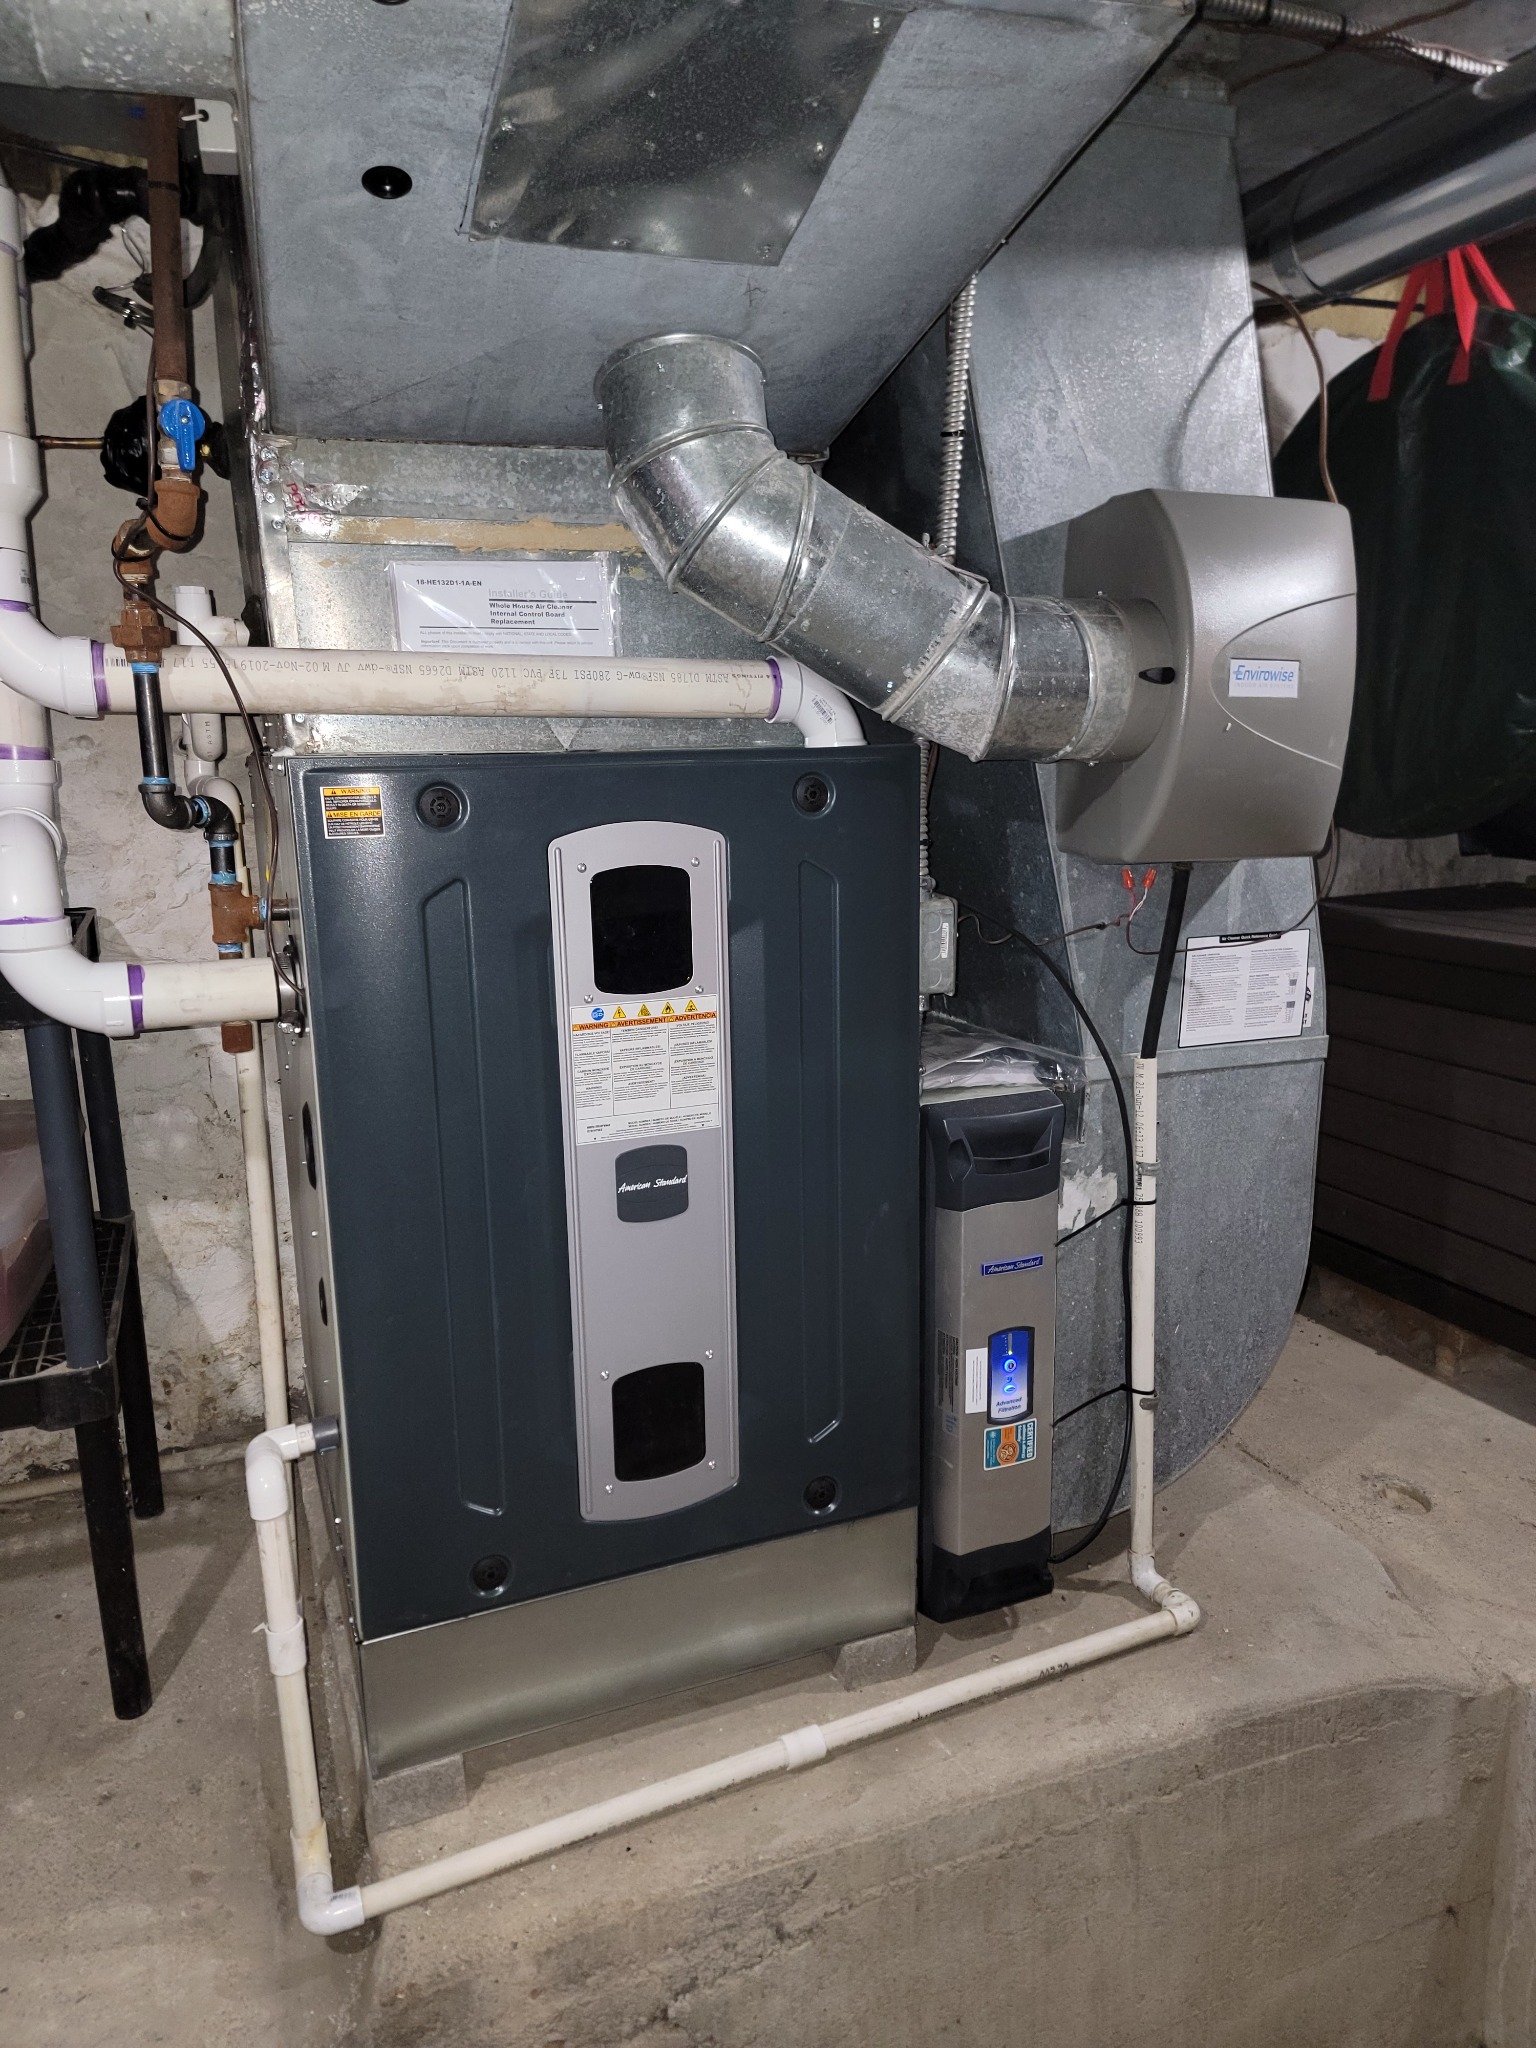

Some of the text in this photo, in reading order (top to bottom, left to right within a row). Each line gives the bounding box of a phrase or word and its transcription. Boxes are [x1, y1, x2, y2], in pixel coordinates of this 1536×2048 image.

[416, 579, 482, 587] 18-HE132D1-1A-EN
[488, 588, 568, 600] Installer's Guide
[322, 662, 330, 671] M
[337, 662, 350, 673] JV
[419, 665, 452, 676] D2665
[459, 666, 484, 676] ASTM
[492, 668, 517, 678] 1120
[523, 668, 542, 679] PVC
[549, 669, 567, 680] 73F
[574, 670, 610, 681] 280PSI
[671, 672, 700, 683] D1785
[706, 673, 729, 683] ASTM
[1233, 665, 1294, 681] Envirowise
[617, 1018, 667, 1027] AVERTISSEMENT
[675, 1013, 716, 1021] ADVERTENCIA
[1135, 1082, 1144, 1118] 21-Jun-12
[617, 1174, 687, 1194] American Standard
[987, 1258, 1040, 1273] American Standard
[996, 1397, 1022, 1414] Advanced Filtration
